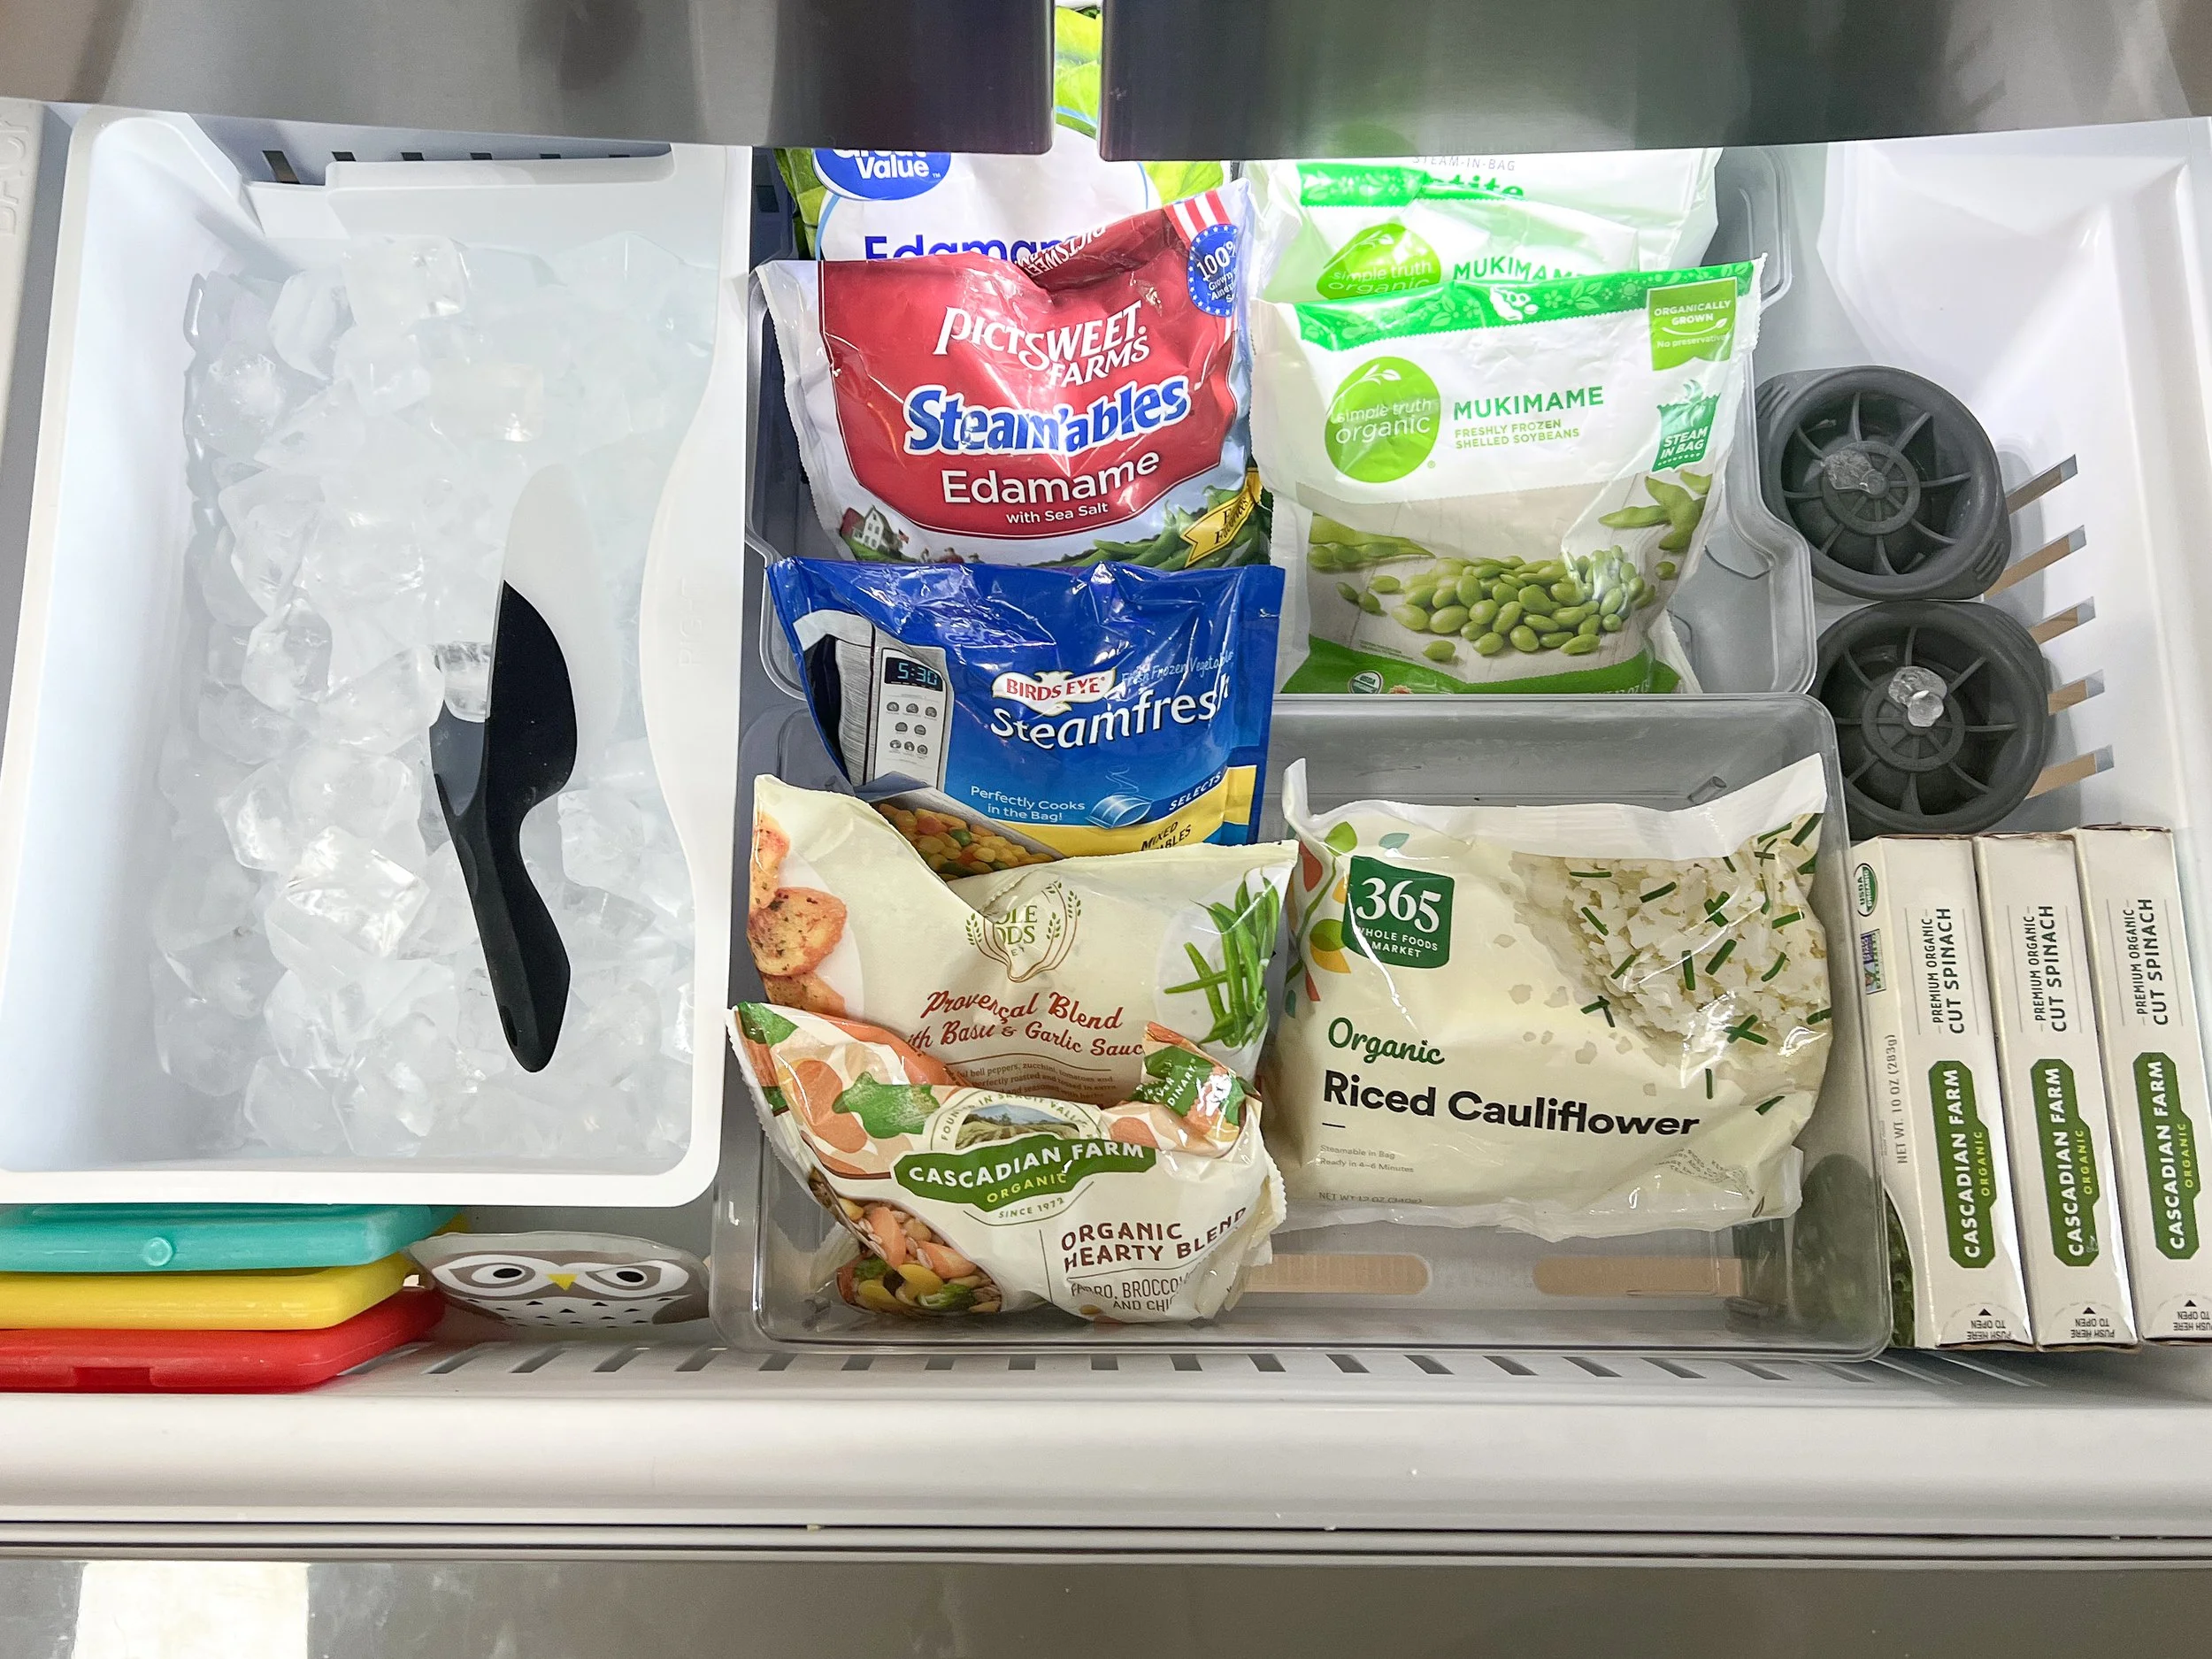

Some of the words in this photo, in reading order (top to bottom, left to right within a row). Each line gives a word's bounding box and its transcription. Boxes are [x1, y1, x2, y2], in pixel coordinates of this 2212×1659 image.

[856, 156, 930, 180] Value
[1392, 261, 1432, 279] truth
[1654, 299, 1732, 317] ORGANICALLY
[1671, 313, 1714, 326] GROWN
[1049, 335, 1150, 388] FARMS
[1335, 403, 1389, 424] simple
[1393, 397, 1432, 415] truth
[1453, 386, 1604, 421] MUKIMAME
[1335, 415, 1431, 444] organic
[1455, 425, 1508, 438] FRESHLY
[1511, 419, 1562, 433] FROZEN
[1455, 436, 1509, 449] SHELLED
[1514, 428, 1579, 444] SOYBEANS
[1664, 426, 1708, 448] STEAM
[1660, 446, 1674, 460] IN
[1677, 439, 1705, 454] BAG
[941, 451, 1160, 504] Edamame
[1006, 511, 1041, 524] with
[1045, 509, 1073, 522] Sea
[1078, 503, 1109, 517] Salt
[897, 662, 938, 686] 5:30
[1151, 664, 1187, 680] Frozen
[1006, 678, 1062, 701] BIRDS
[1066, 677, 1101, 695] EYE
[971, 786, 1035, 810] Perfectly
[1038, 800, 1085, 810] Cooks
[1169, 772, 1221, 811] SELECTS
[987, 803, 1000, 815] in
[1002, 807, 1028, 818] the
[1031, 810, 1063, 823] Bag!
[1141, 821, 1179, 851] MIXED
[1356, 877, 1441, 933] 365
[1402, 934, 1438, 951] FOODS
[1922, 918, 1938, 968] ORGANIC
[2024, 916, 2039, 965] ORGANIC
[2039, 906, 2062, 987] SPINACH
[2123, 909, 2140, 959] ORGANIC
[2138, 899, 2162, 981] SPINACH
[1372, 941, 1421, 958] MARKET
[1936, 908, 1959, 989] SPINACH
[1929, 972, 1944, 1023] PREMIUM
[2030, 970, 2047, 1021] PREMIUM
[2131, 964, 2148, 1015] PREMIUM
[1048, 991, 1124, 1030] Blend
[1947, 998, 1964, 1033] CUT
[2049, 996, 2067, 1032] CUT
[2150, 989, 2168, 1025] CUT
[908, 1026, 933, 1049] ith
[1001, 1025, 1018, 1037] &
[1025, 1021, 1083, 1053] Garlic
[1090, 1038, 1144, 1056] Sauc
[1327, 1017, 1445, 1065] Organic
[1885, 1034, 1899, 1075] (283g)
[979, 1094, 993, 1106] IN
[1890, 1079, 1901, 1094] OZ
[1943, 1069, 1965, 1125] FARM
[2045, 1068, 2066, 1124] FARM
[2147, 1061, 2169, 1117] FARM
[1324, 1069, 1437, 1117] Riced
[1448, 1090, 1700, 1136] Cauliflower
[1891, 1099, 1901, 1112] 10
[909, 1148, 1061, 1188] CASCADIAN
[1071, 1141, 1144, 1161] FARM
[1320, 1144, 1366, 1156] Steamable
[1379, 1150, 1395, 1160] Bag
[1320, 1157, 1346, 1167] Ready
[1379, 1164, 1414, 1172] Minutes
[1896, 1149, 1908, 1164] NET
[1973, 1132, 1991, 1196] ORGANIC
[2075, 1130, 2093, 1194] ORGANIC
[2177, 1124, 2193, 1188] ORGANIC
[986, 1173, 1066, 1203] ORGANIC
[1318, 1192, 1336, 1201] NET
[1950, 1133, 1981, 1258] CASCADIAN
[2053, 1132, 2085, 1256] CASCADIAN
[2155, 1125, 2185, 1249] CASCADIAN
[998, 1205, 1033, 1218] SINCE
[1037, 1197, 1064, 1212] 1972
[1062, 1222, 1183, 1251] ORGANIC
[1064, 1244, 1164, 1272] HEARTY
[1177, 1207, 1246, 1259] BLEND
[1113, 1300, 1141, 1310] AND
[2177, 1310, 2199, 1320] OPEN
[2200, 1310, 2210, 1320] TO
[1967, 1331, 1988, 1340] HERE
[1970, 1319, 1993, 1329] OPEN
[1990, 1330, 2013, 1340] PUSH
[1995, 1319, 2007, 1329] TO
[2070, 1329, 2091, 1339] HERE
[2075, 1317, 2098, 1327] OPEN
[2093, 1329, 2116, 1339] PUSH
[2099, 1317, 2110, 1327] TO
[2173, 1322, 2194, 1332] HERE
